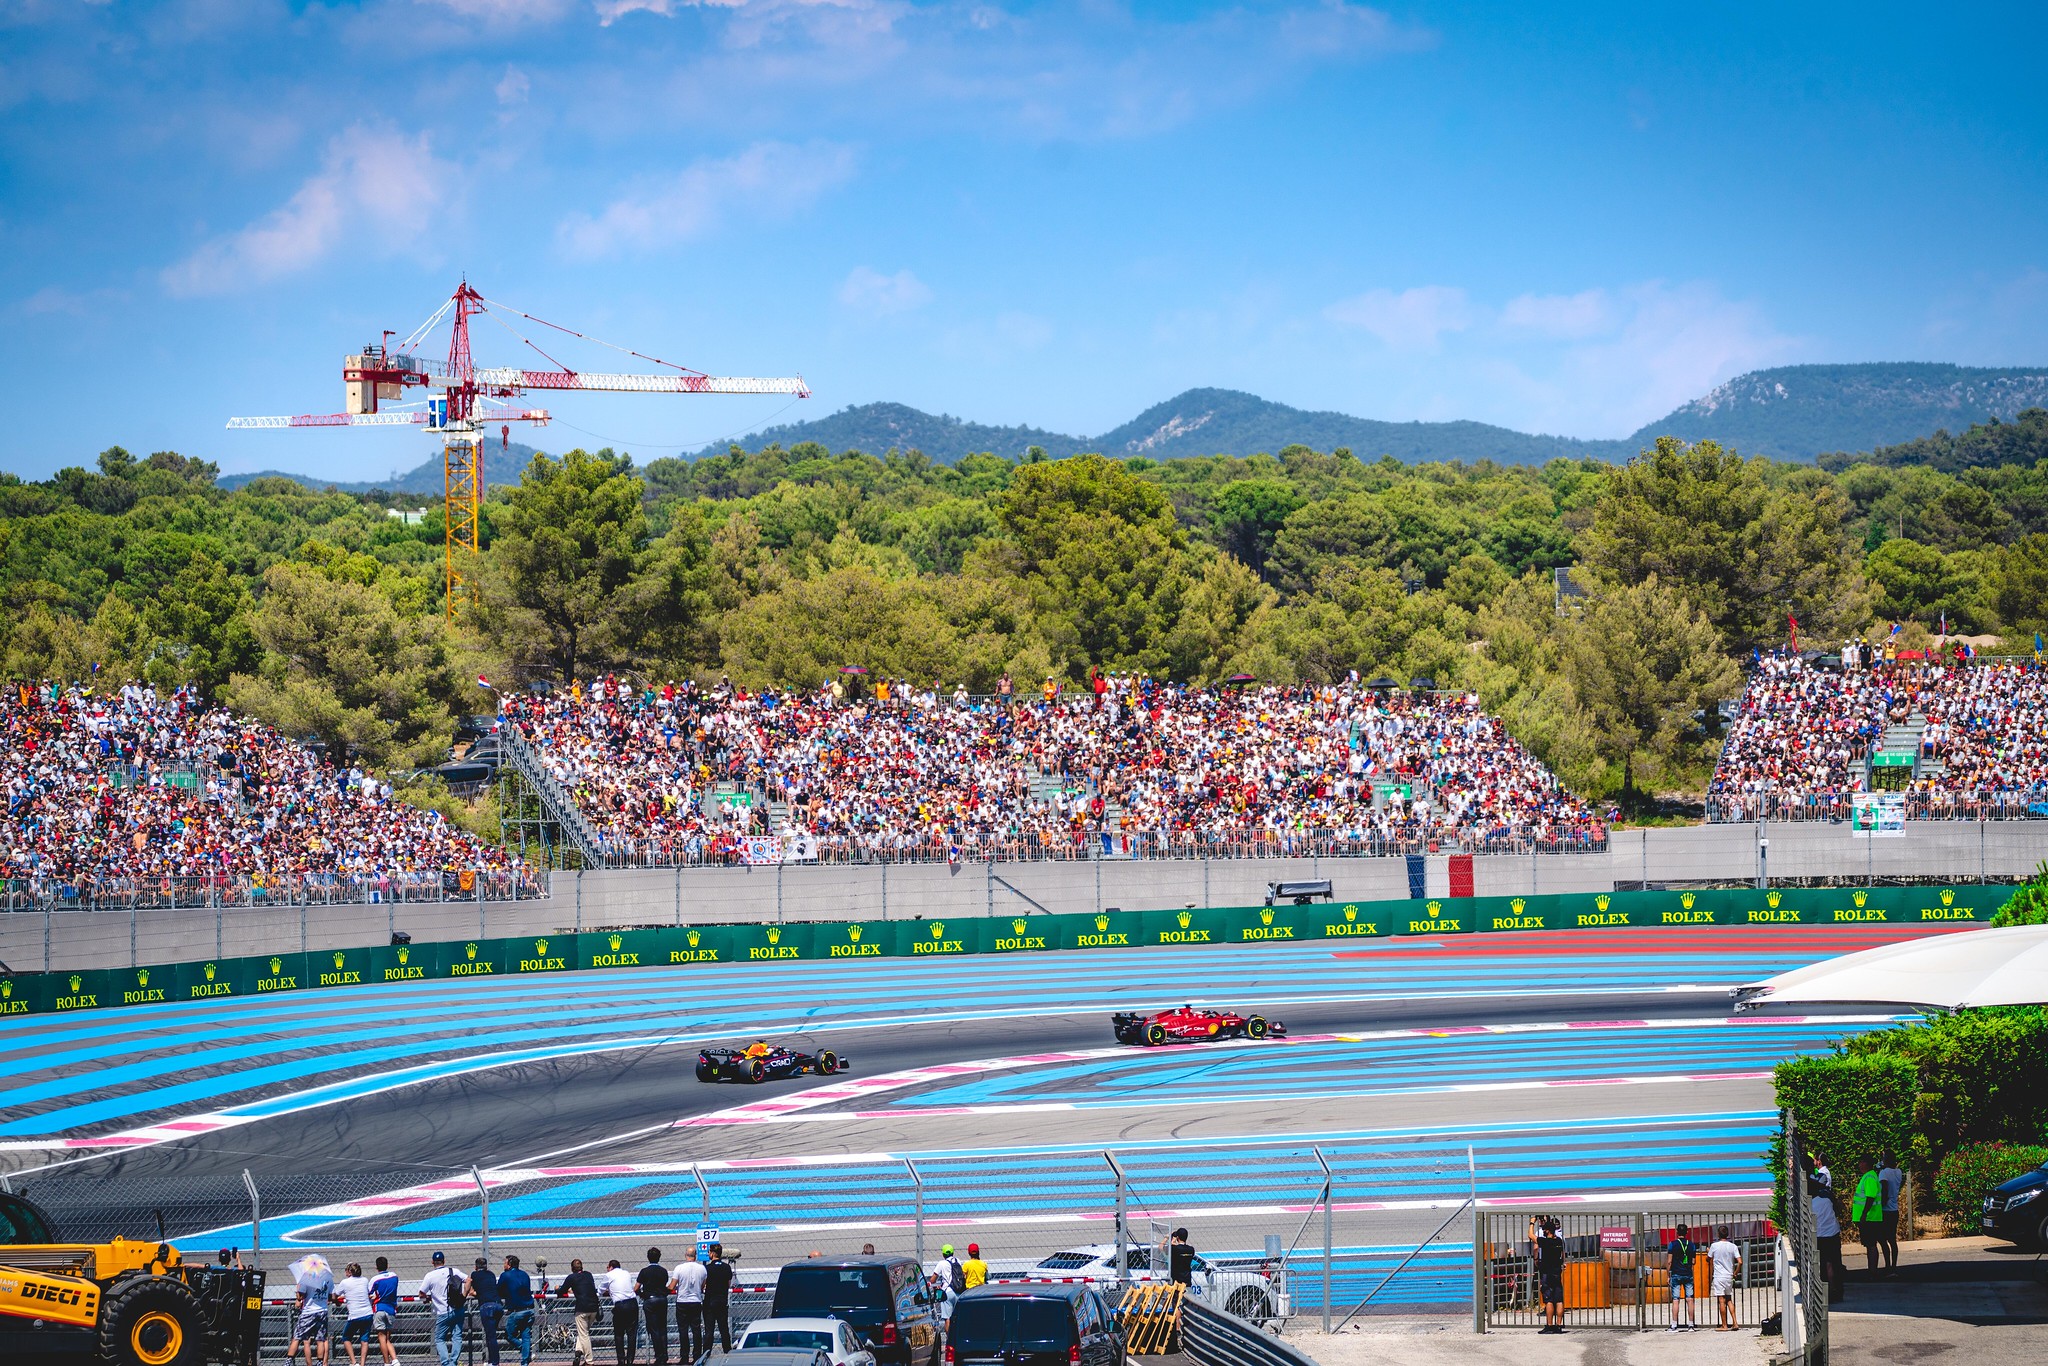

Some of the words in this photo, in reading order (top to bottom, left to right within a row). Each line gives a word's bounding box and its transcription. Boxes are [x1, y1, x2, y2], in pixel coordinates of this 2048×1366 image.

[1577, 912, 1630, 926] ROLEX
[1661, 911, 1715, 923] ROLEX
[1747, 910, 1801, 922] ROLEX
[1833, 909, 1888, 921] ROLEX
[1920, 907, 1975, 920] ROLEX
[1325, 923, 1378, 936] ROLEX
[1408, 919, 1461, 932] ROLEX
[1492, 916, 1545, 929] ROLEX
[1077, 933, 1129, 947] ROLEX
[1159, 929, 1211, 943] ROLEX
[1242, 926, 1294, 940] ROLEX
[830, 943, 882, 957] ROLEX
[913, 940, 964, 954] ROLEX
[995, 936, 1046, 950] ROLEX
[669, 949, 719, 963] ROLEX
[749, 946, 800, 959] ROLEX
[519, 957, 566, 972] ROLEX
[592, 953, 640, 967] ROLEX
[384, 966, 424, 980] ROLEX
[451, 962, 493, 976] ROLEX
[257, 976, 297, 991] ROLEX
[319, 971, 361, 986] ROLEX
[123, 989, 165, 1003] ROLEX
[191, 982, 232, 997] ROLEX
[0, 1000, 29, 1014] LEX
[56, 994, 97, 1010] ROLEX
[703, 1230, 717, 1240] 87
[21, 1282, 81, 1306] DIECI
